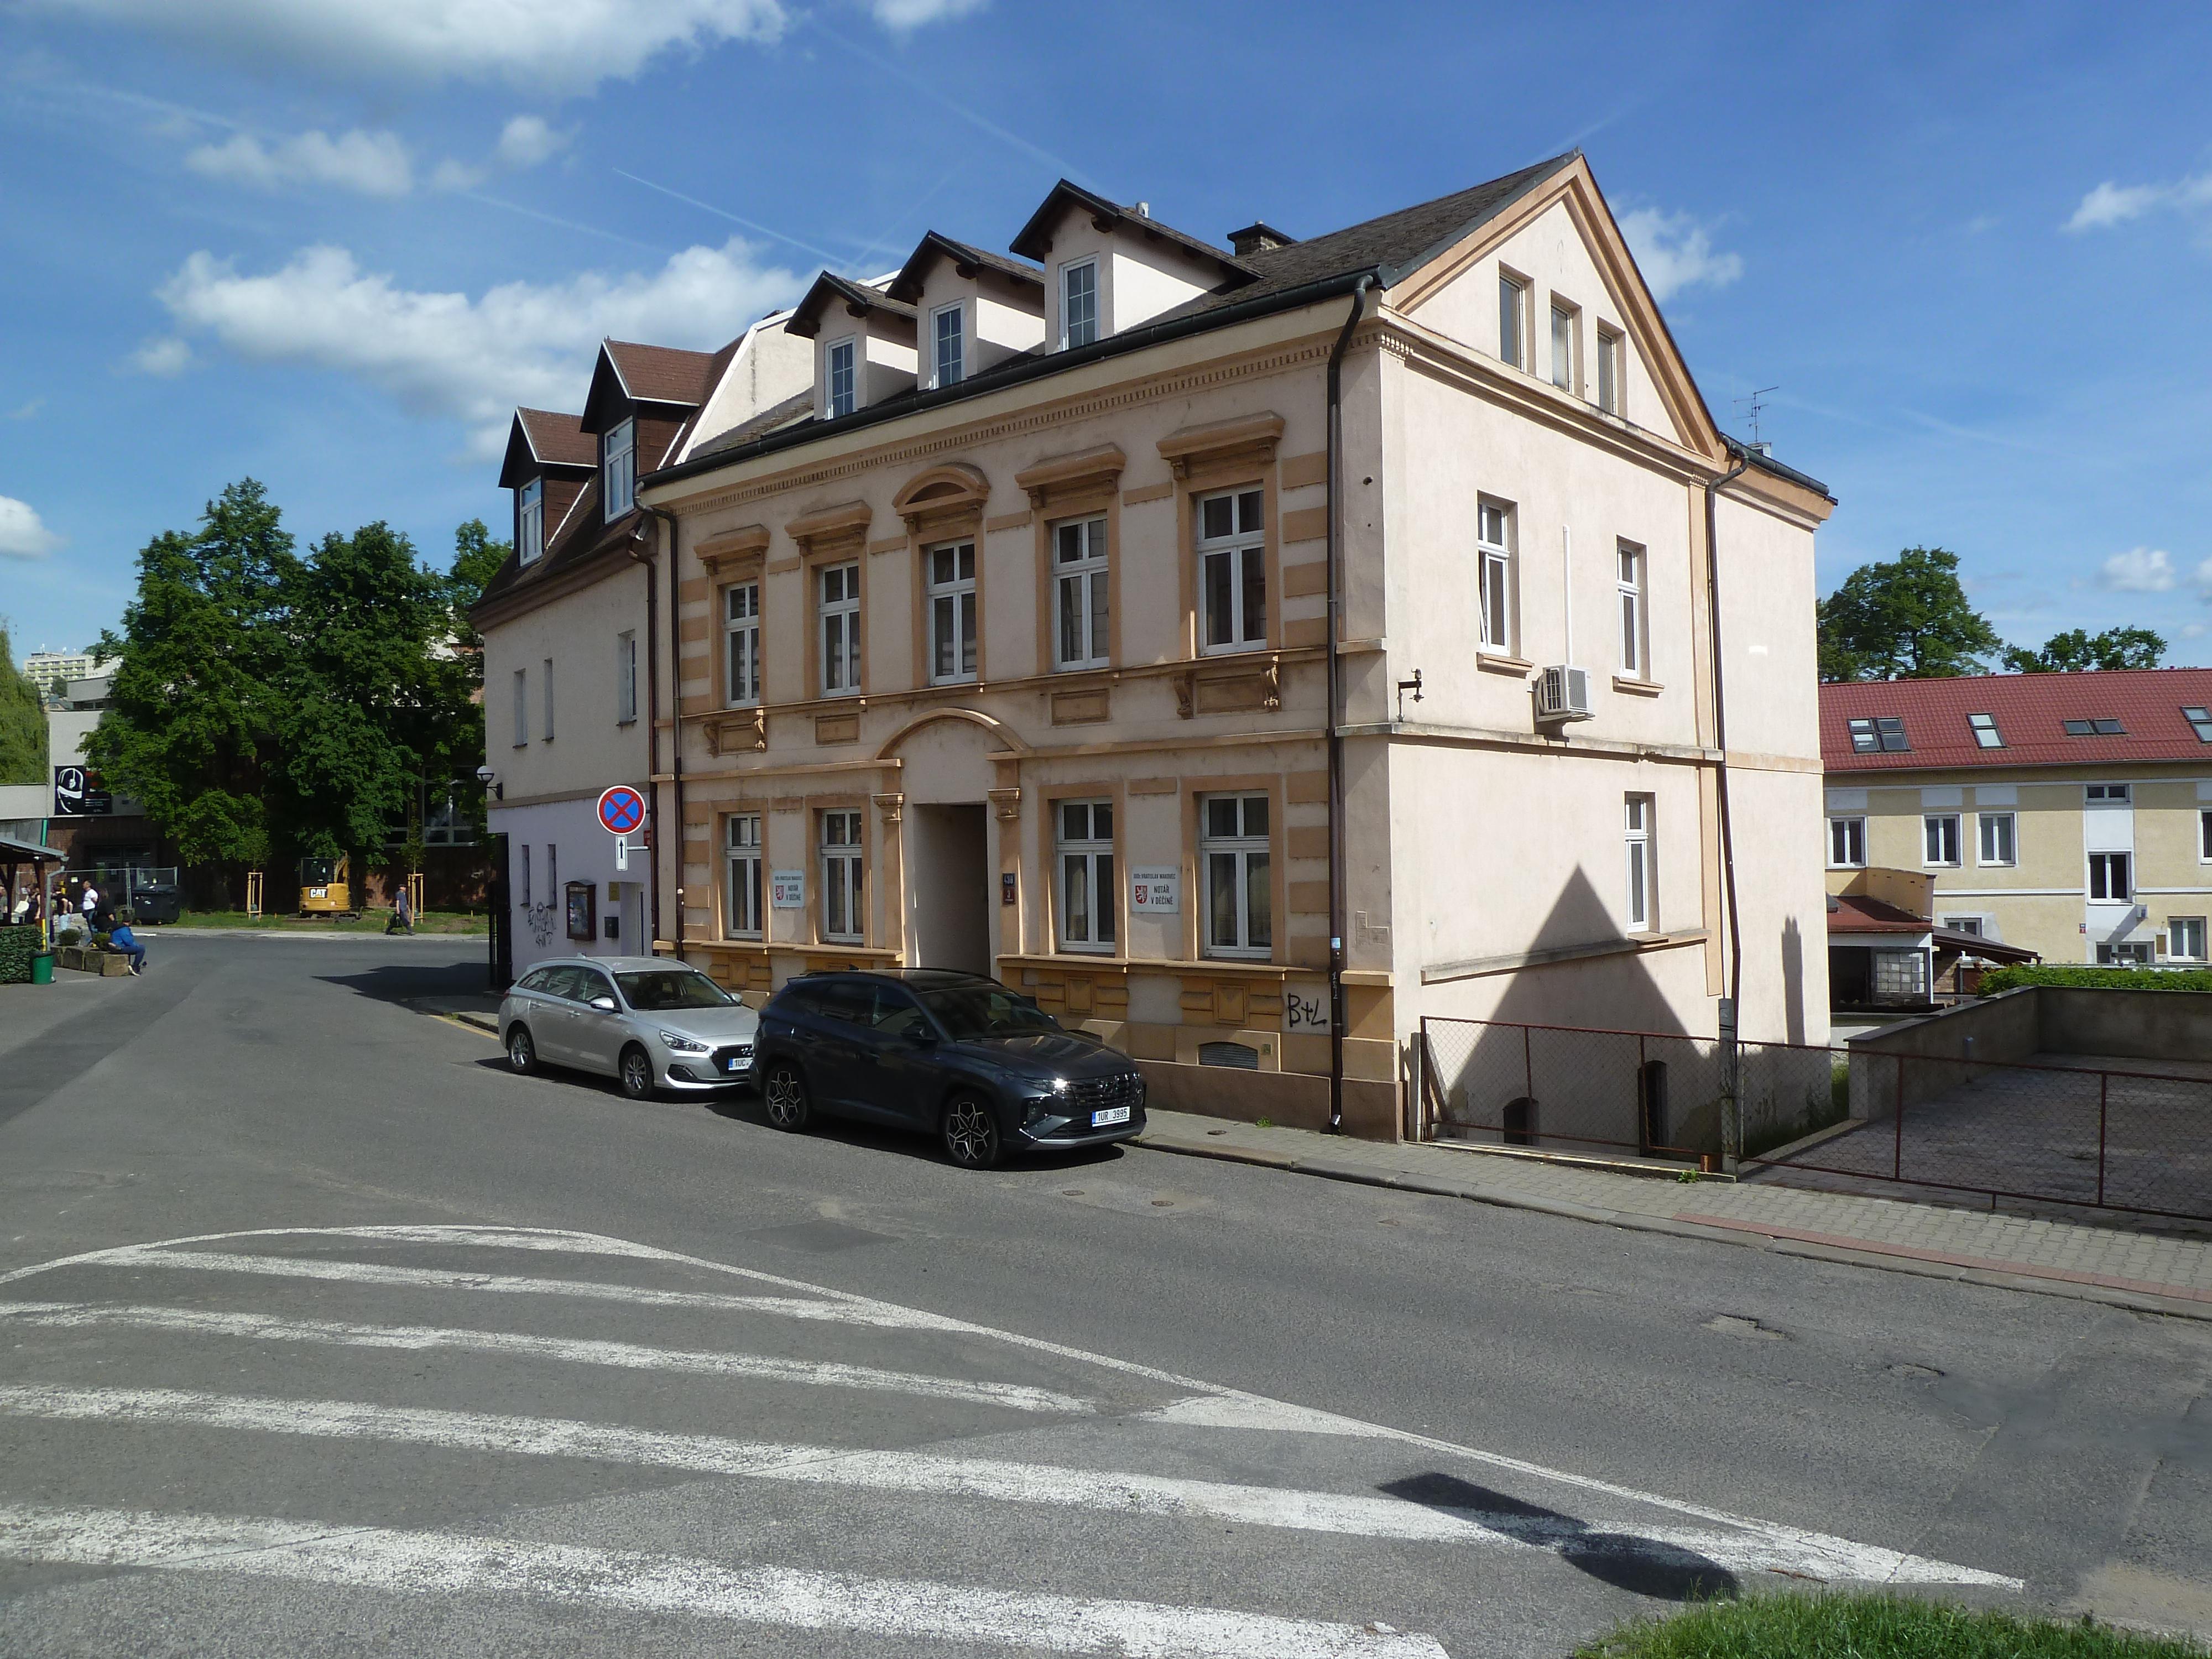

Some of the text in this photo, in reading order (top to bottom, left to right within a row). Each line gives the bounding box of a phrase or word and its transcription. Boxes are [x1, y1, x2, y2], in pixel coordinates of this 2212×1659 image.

[310, 889, 327, 898] CAT
[1154, 884, 1170, 894] NOTÁŘ
[1155, 895, 1173, 905] DĚČÍNĚ
[1097, 1108, 1128, 1121] 1UR 3995
